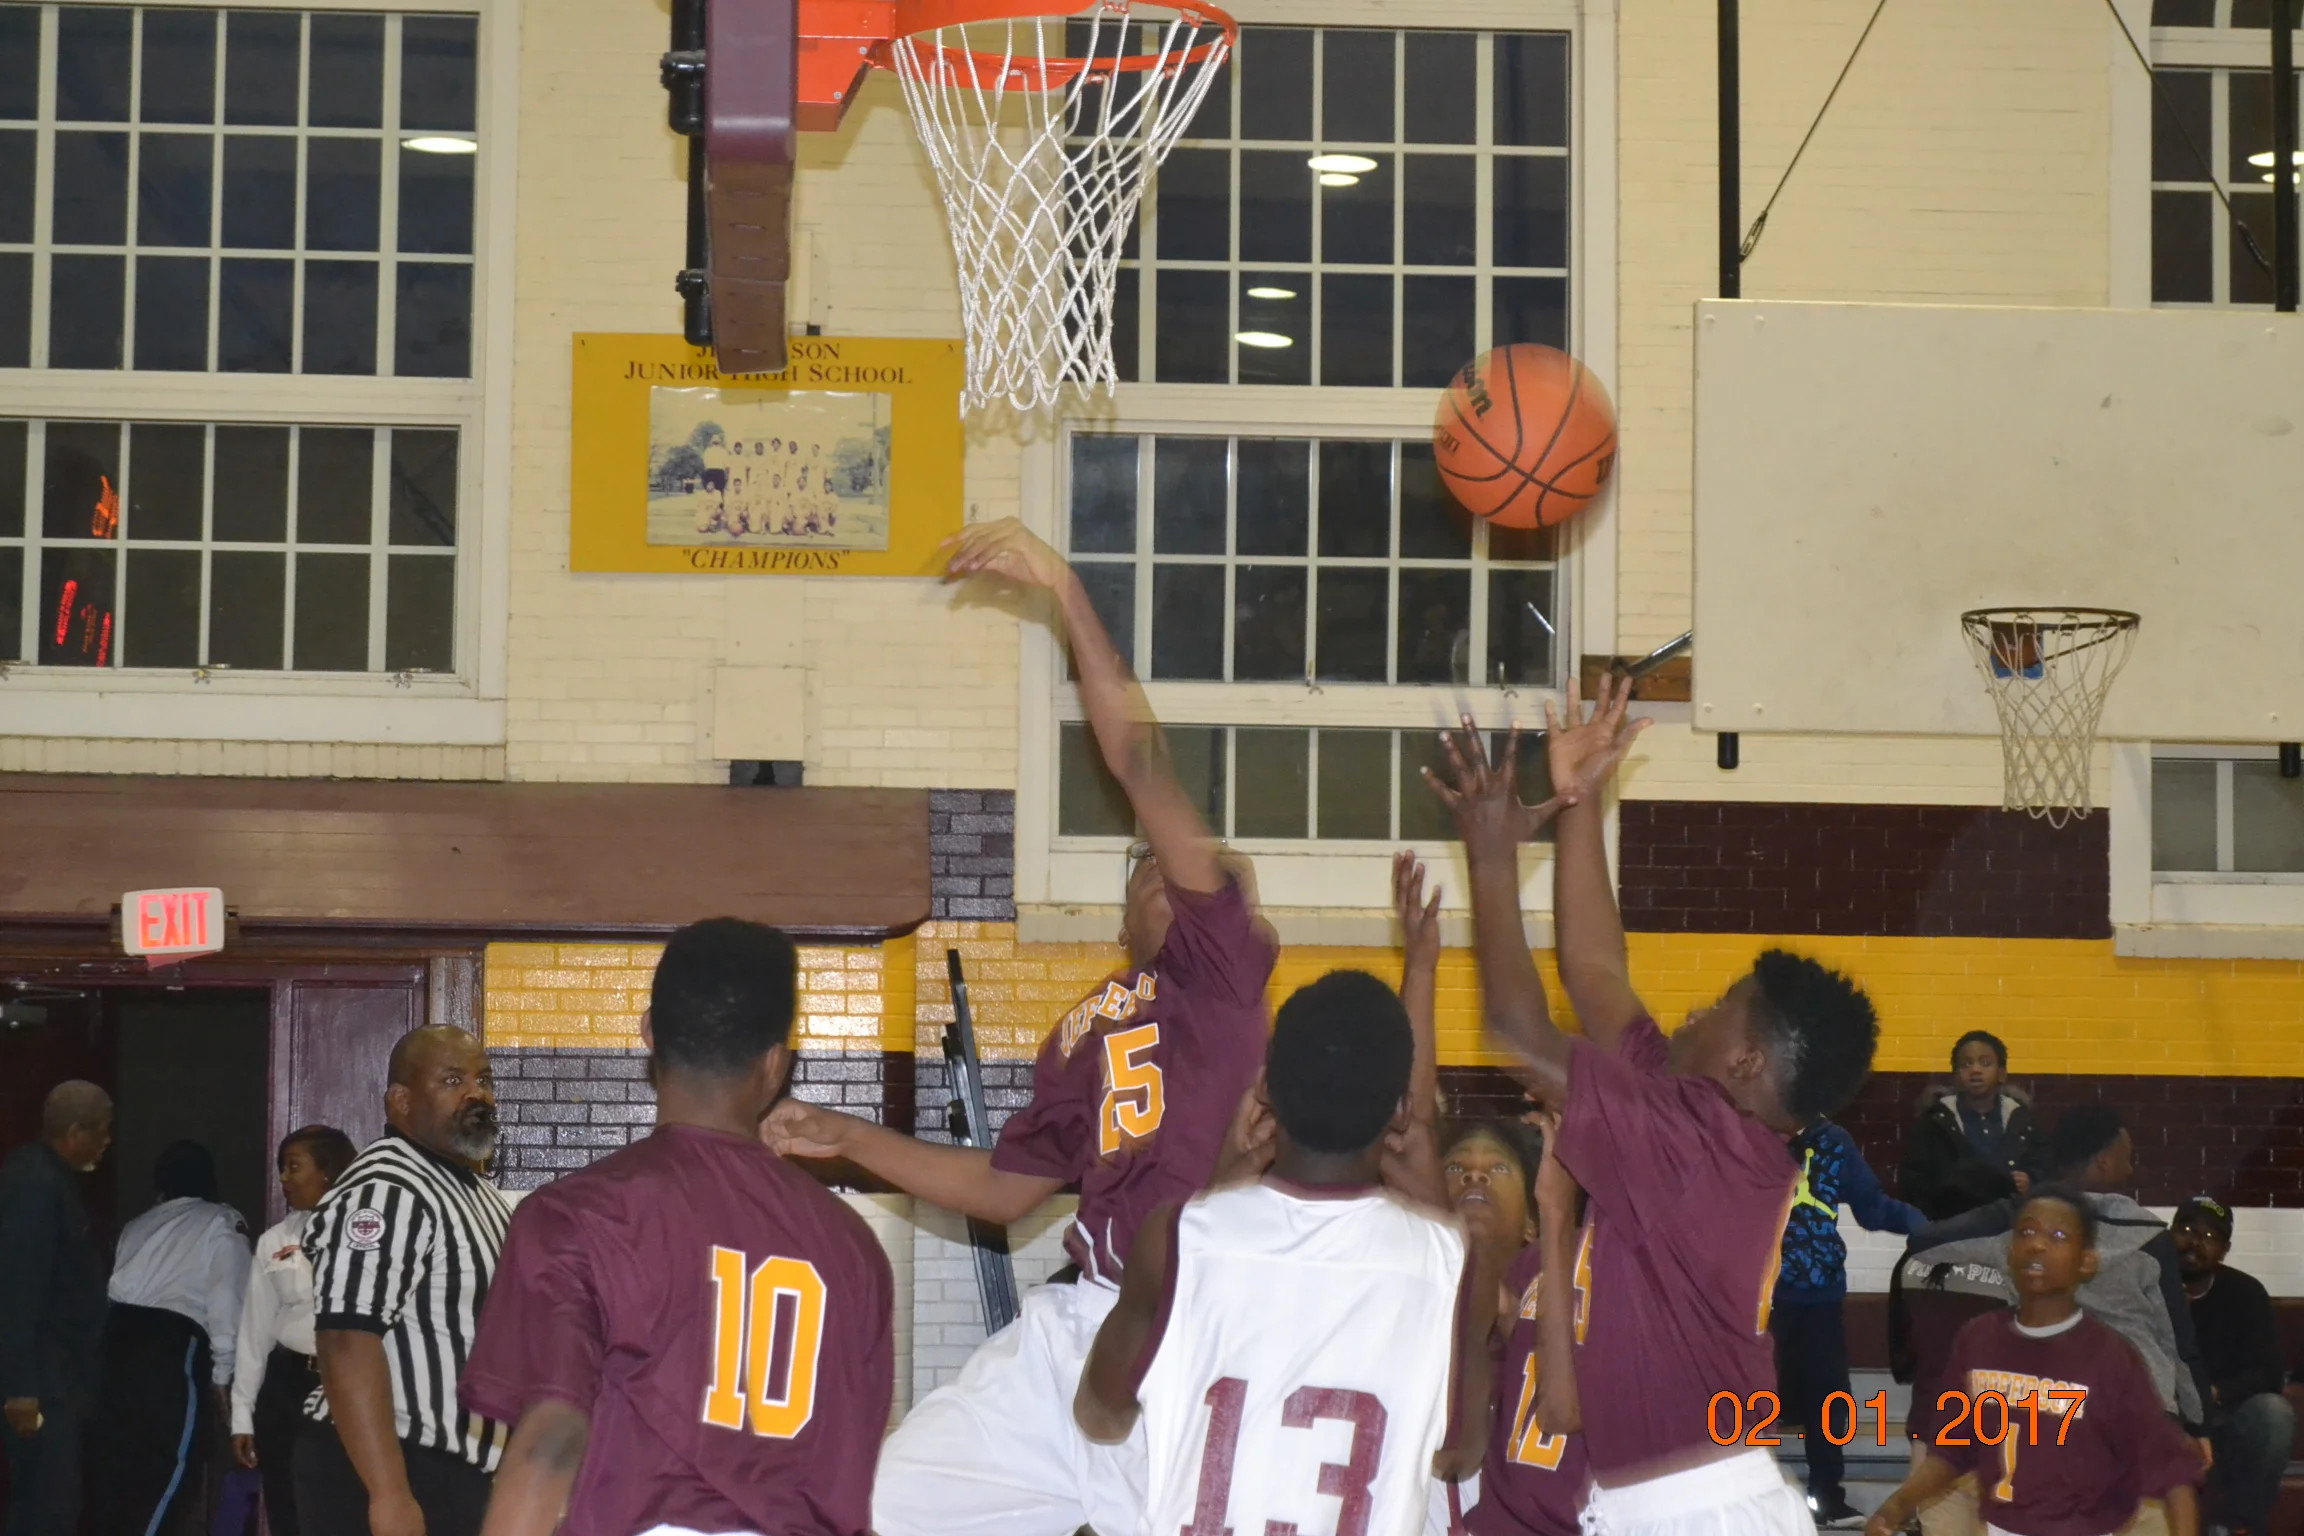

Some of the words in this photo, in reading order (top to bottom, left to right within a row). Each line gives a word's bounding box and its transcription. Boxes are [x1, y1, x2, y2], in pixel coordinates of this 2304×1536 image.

[623, 361, 720, 381] JUNIOR
[808, 363, 912, 384] SCHOOL
[138, 891, 211, 949] EXIT
[1967, 1263, 2006, 1287] PIN
[702, 1245, 827, 1439] 10
[1180, 1376, 1389, 1536] 13
[1996, 1422, 2020, 1502] 1
